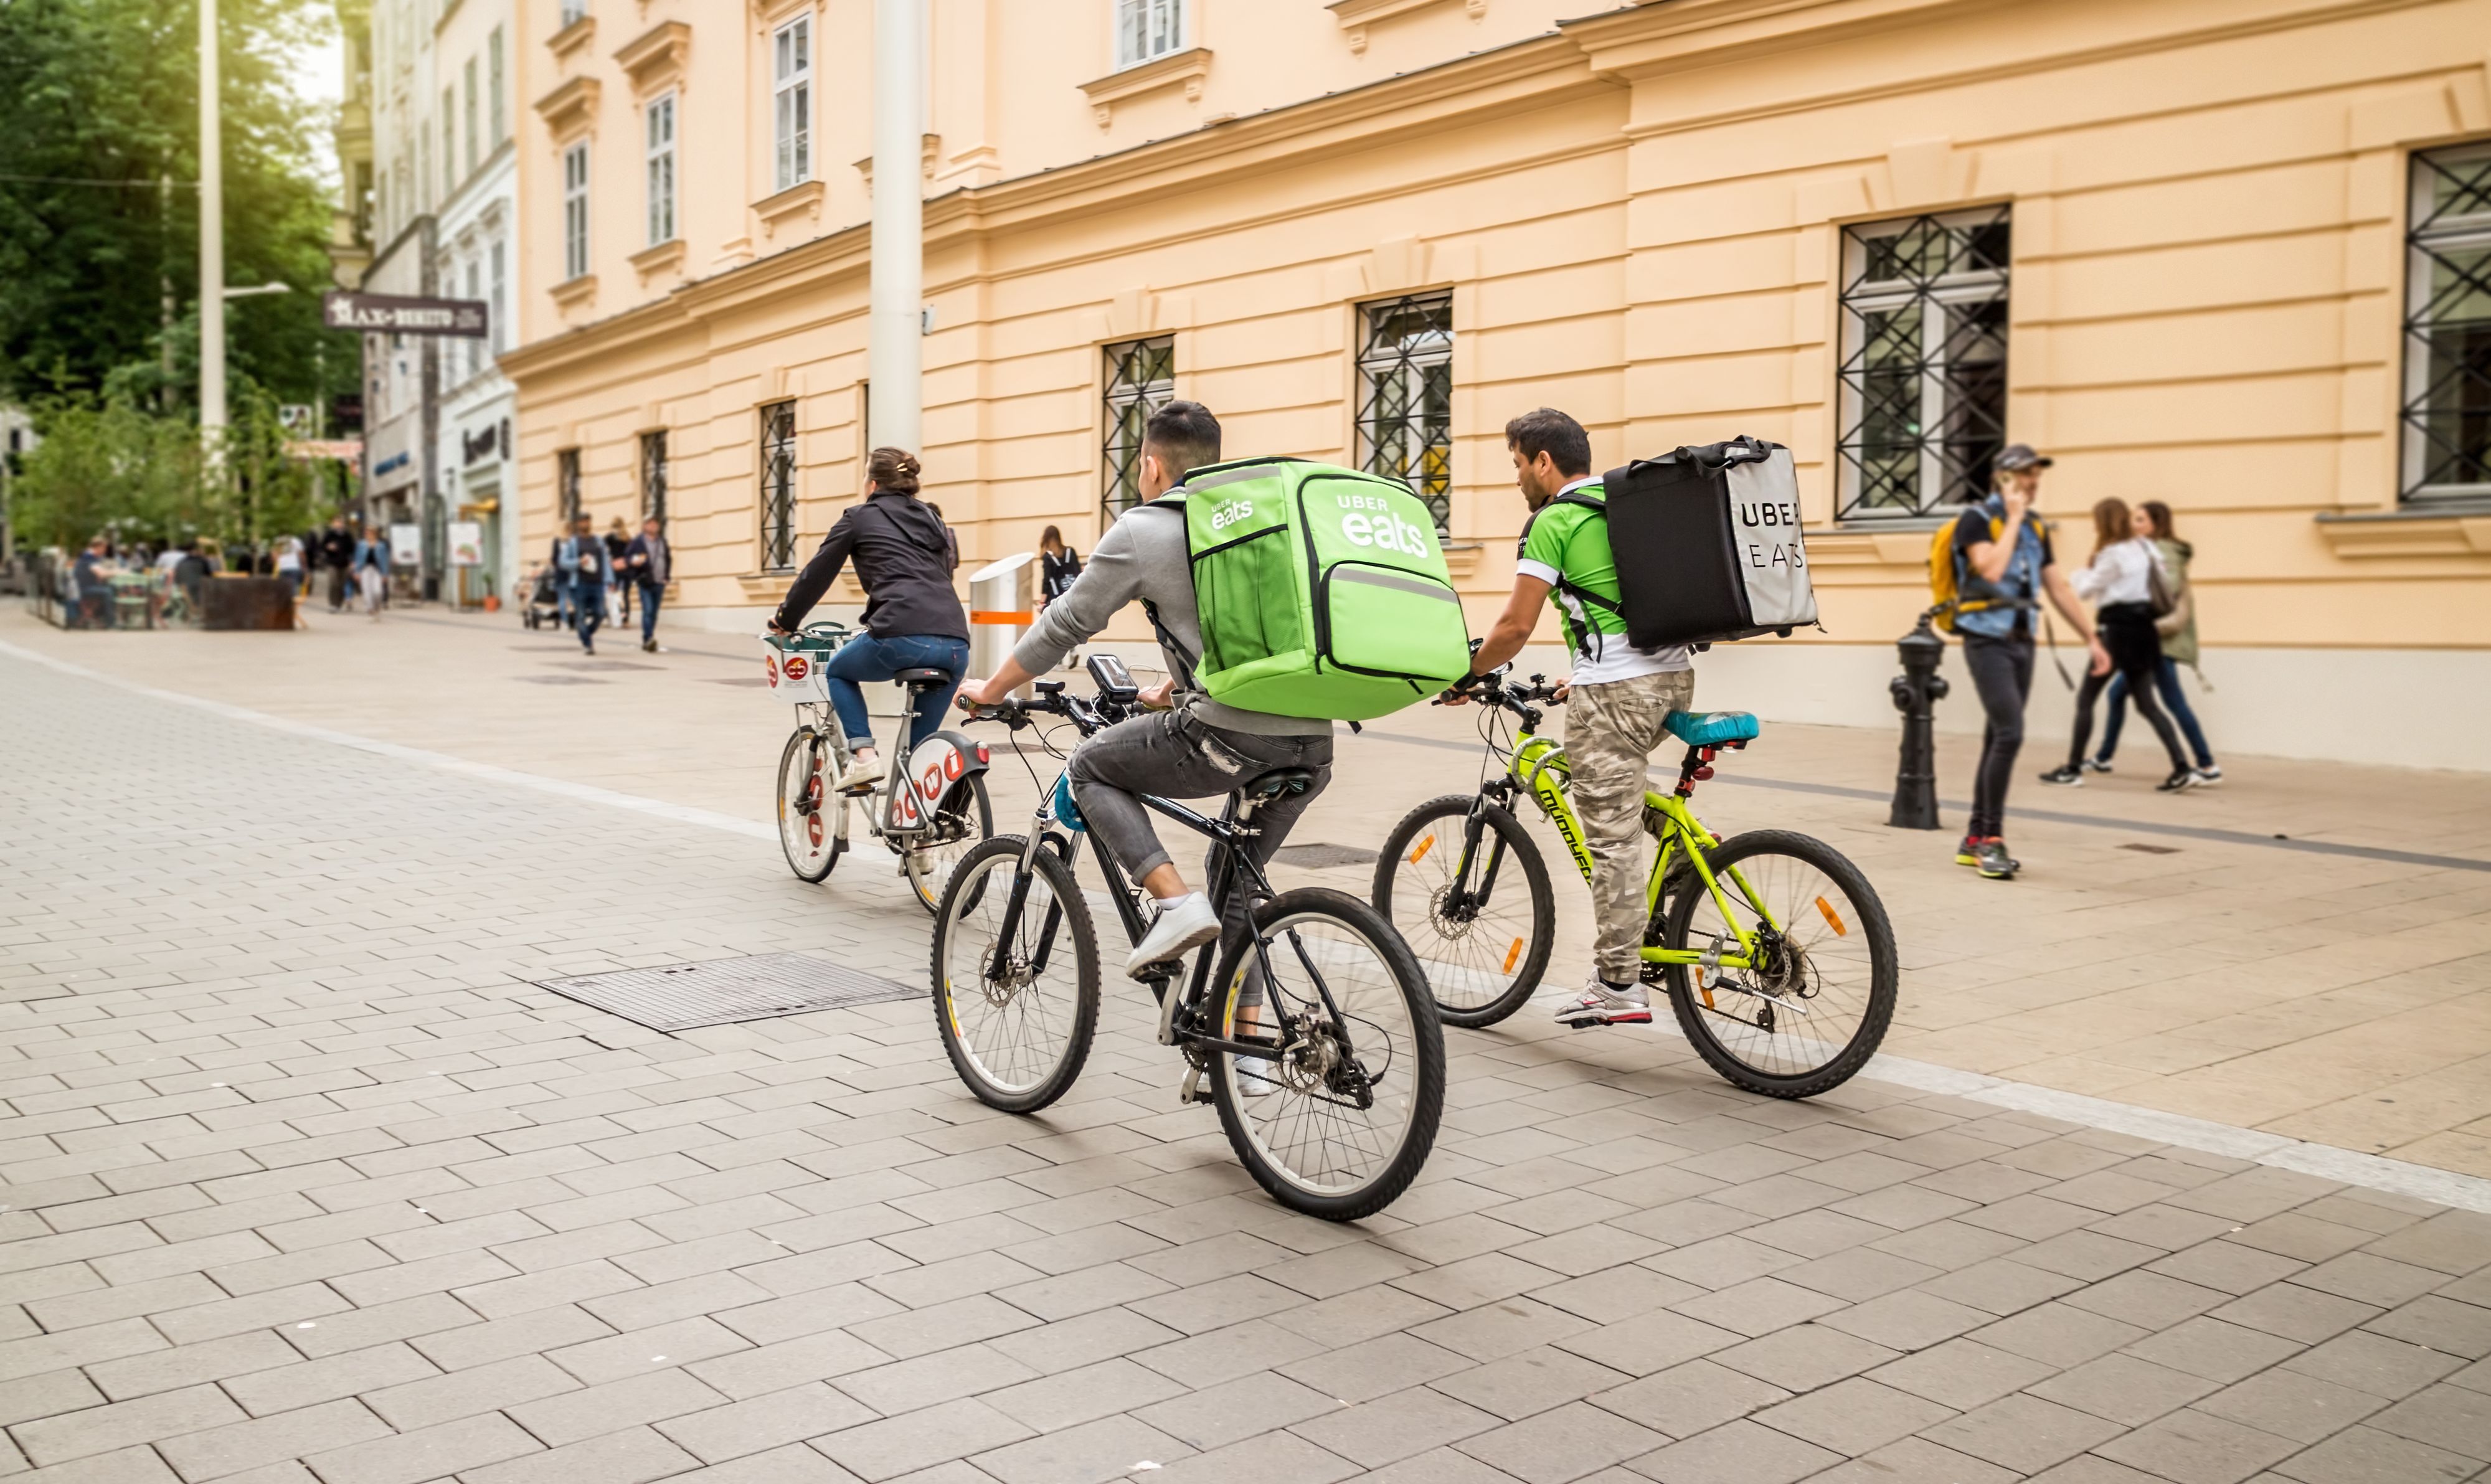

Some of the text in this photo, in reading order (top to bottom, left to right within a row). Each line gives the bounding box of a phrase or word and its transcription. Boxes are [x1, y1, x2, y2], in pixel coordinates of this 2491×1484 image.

[1211, 498, 1231, 513] UBER
[1212, 501, 1254, 530] eats
[1337, 496, 1388, 511] UBER
[1341, 512, 1429, 559] eats
[1749, 544, 1803, 569] EATS
[1539, 789, 1592, 889] MUDDYFO
